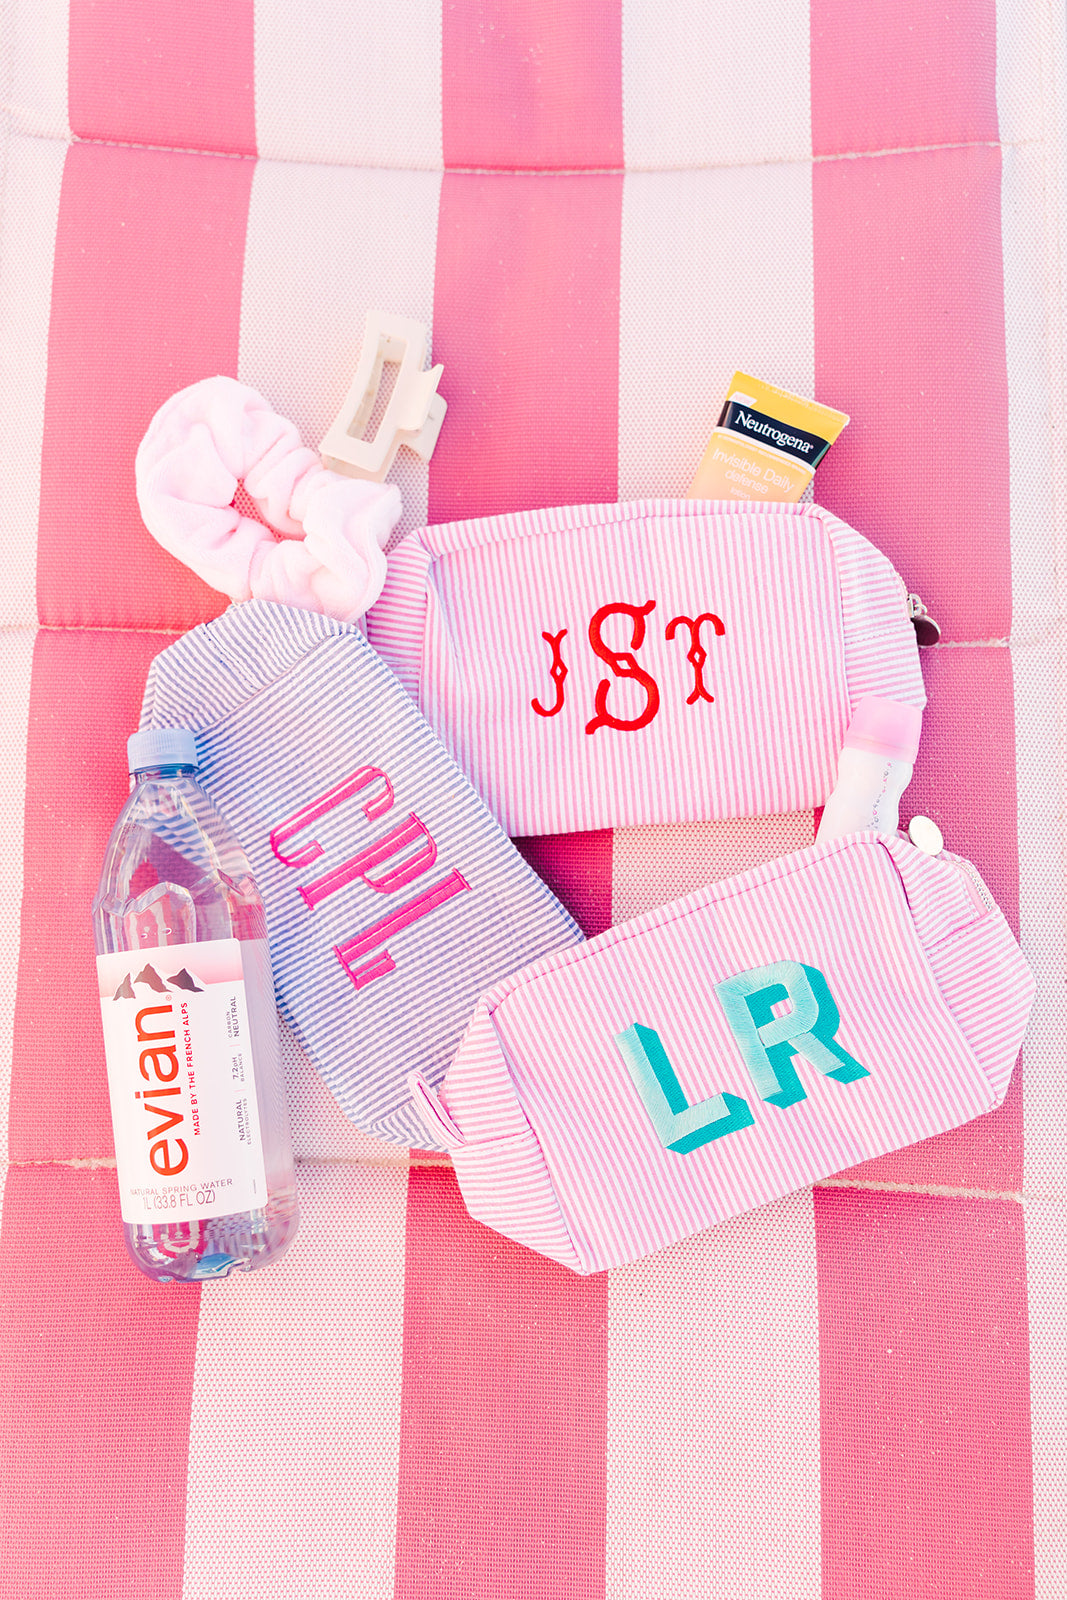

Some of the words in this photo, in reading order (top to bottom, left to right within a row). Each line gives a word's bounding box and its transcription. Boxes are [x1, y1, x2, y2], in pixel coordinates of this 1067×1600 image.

[734, 410, 811, 454] Neutrogena
[712, 447, 760, 477] Invisible
[763, 468, 795, 493] Daily
[725, 469, 769, 495] defense
[269, 765, 473, 991] CPL
[180, 1002, 190, 1026] ALPS
[225, 1011, 233, 1038] CARBON
[229, 996, 240, 1037] NEUTRAL
[183, 1029, 194, 1067] FRENCH
[612, 959, 871, 1155] LR
[187, 1070, 196, 1089] THE
[237, 1053, 245, 1082] BALANCE
[134, 1004, 189, 1177] evian
[189, 1092, 198, 1105] BY
[191, 1107, 201, 1136] MADE
[235, 1098, 246, 1141] NATURAL
[242, 1097, 252, 1145] ELECTROLYTES
[130, 1187, 158, 1196] NATURAL
[162, 1184, 197, 1195] SPRING
[200, 1178, 233, 1190] WATER
[143, 1197, 151, 1210] 1L
[153, 1194, 177, 1210] (33.8
[180, 1193, 193, 1207] FL
[196, 1190, 216, 1205] OZ)
